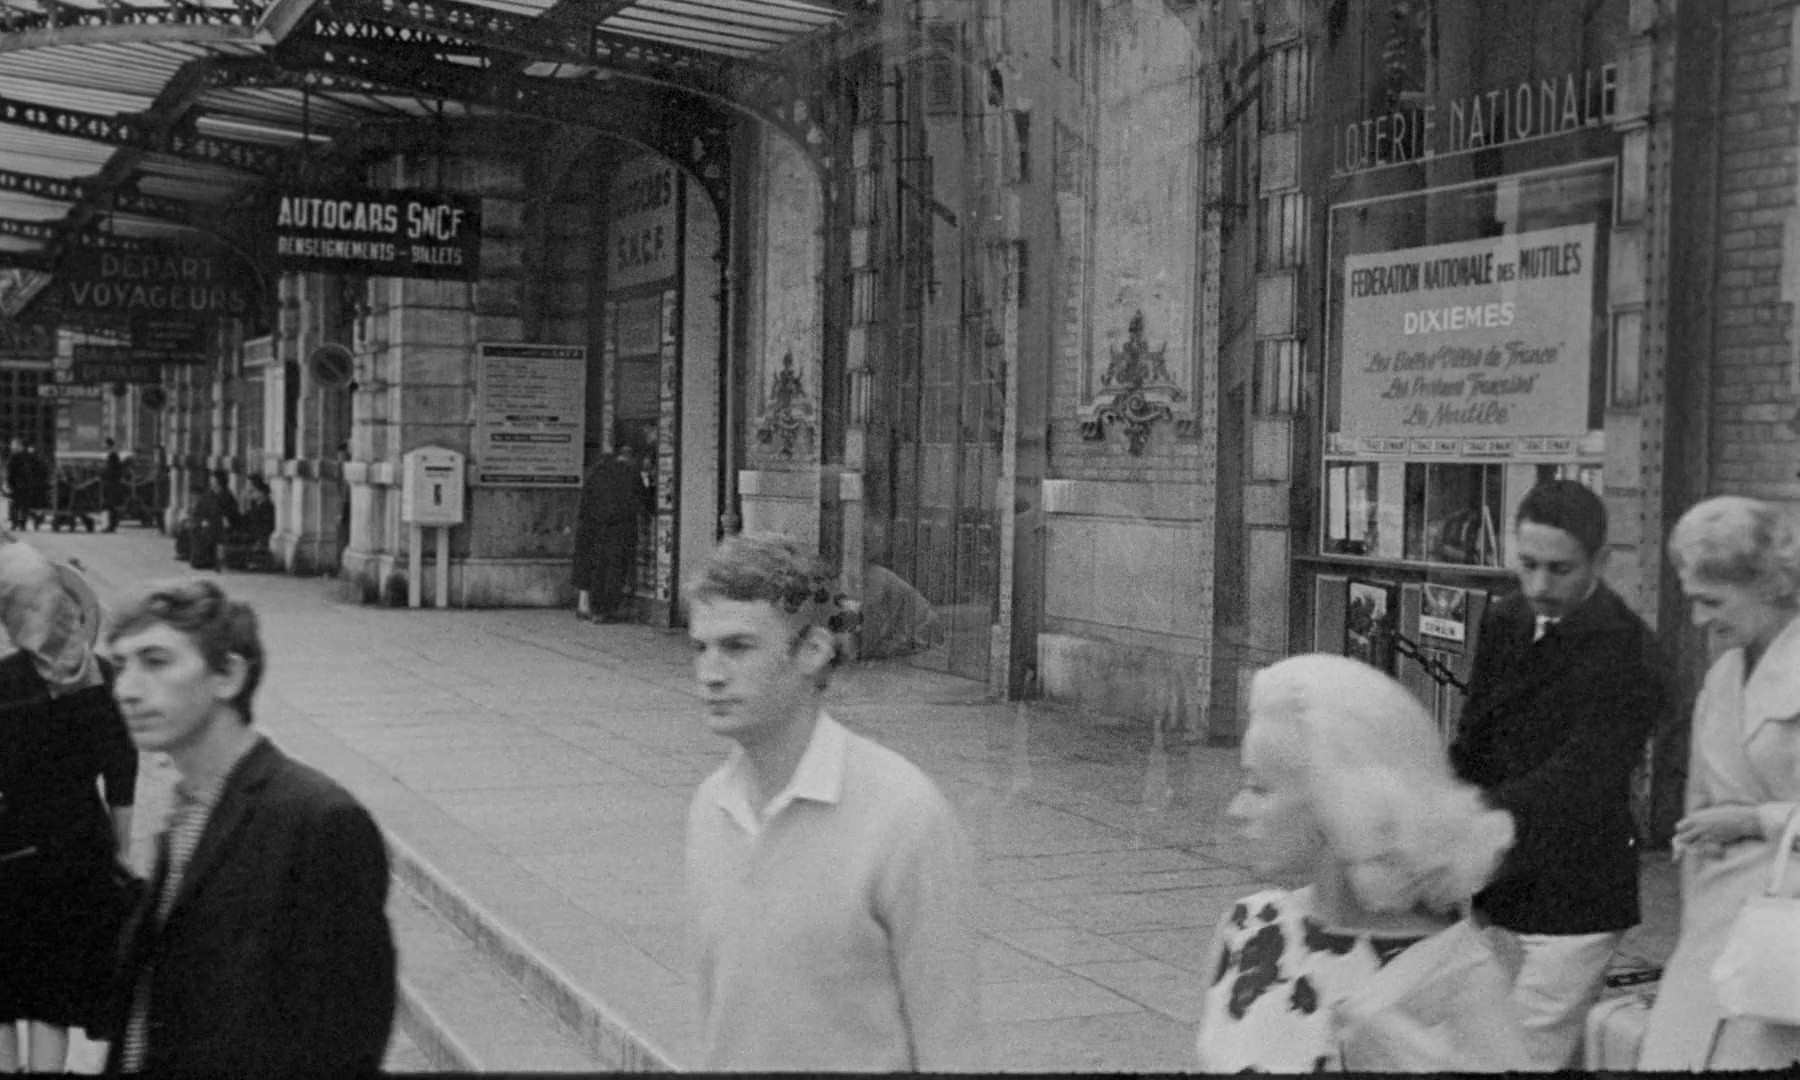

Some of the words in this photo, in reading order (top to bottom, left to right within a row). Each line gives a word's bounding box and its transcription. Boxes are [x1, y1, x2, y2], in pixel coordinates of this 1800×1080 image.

[1331, 103, 1437, 175] LOTERIE
[1449, 63, 1617, 152] NATIONALE
[277, 196, 398, 234] AUTOCARS
[277, 236, 396, 262] RENSEIGNEMENTS
[411, 244, 463, 266] BILLETS
[1350, 262, 1420, 299] FEDERATION
[1423, 252, 1494, 291] NATIONALE
[1496, 262, 1515, 283] DES
[1518, 241, 1582, 281] MUTILES
[69, 280, 246, 313] VOYAGEURS
[1403, 300, 1516, 336] DIXIEMES
